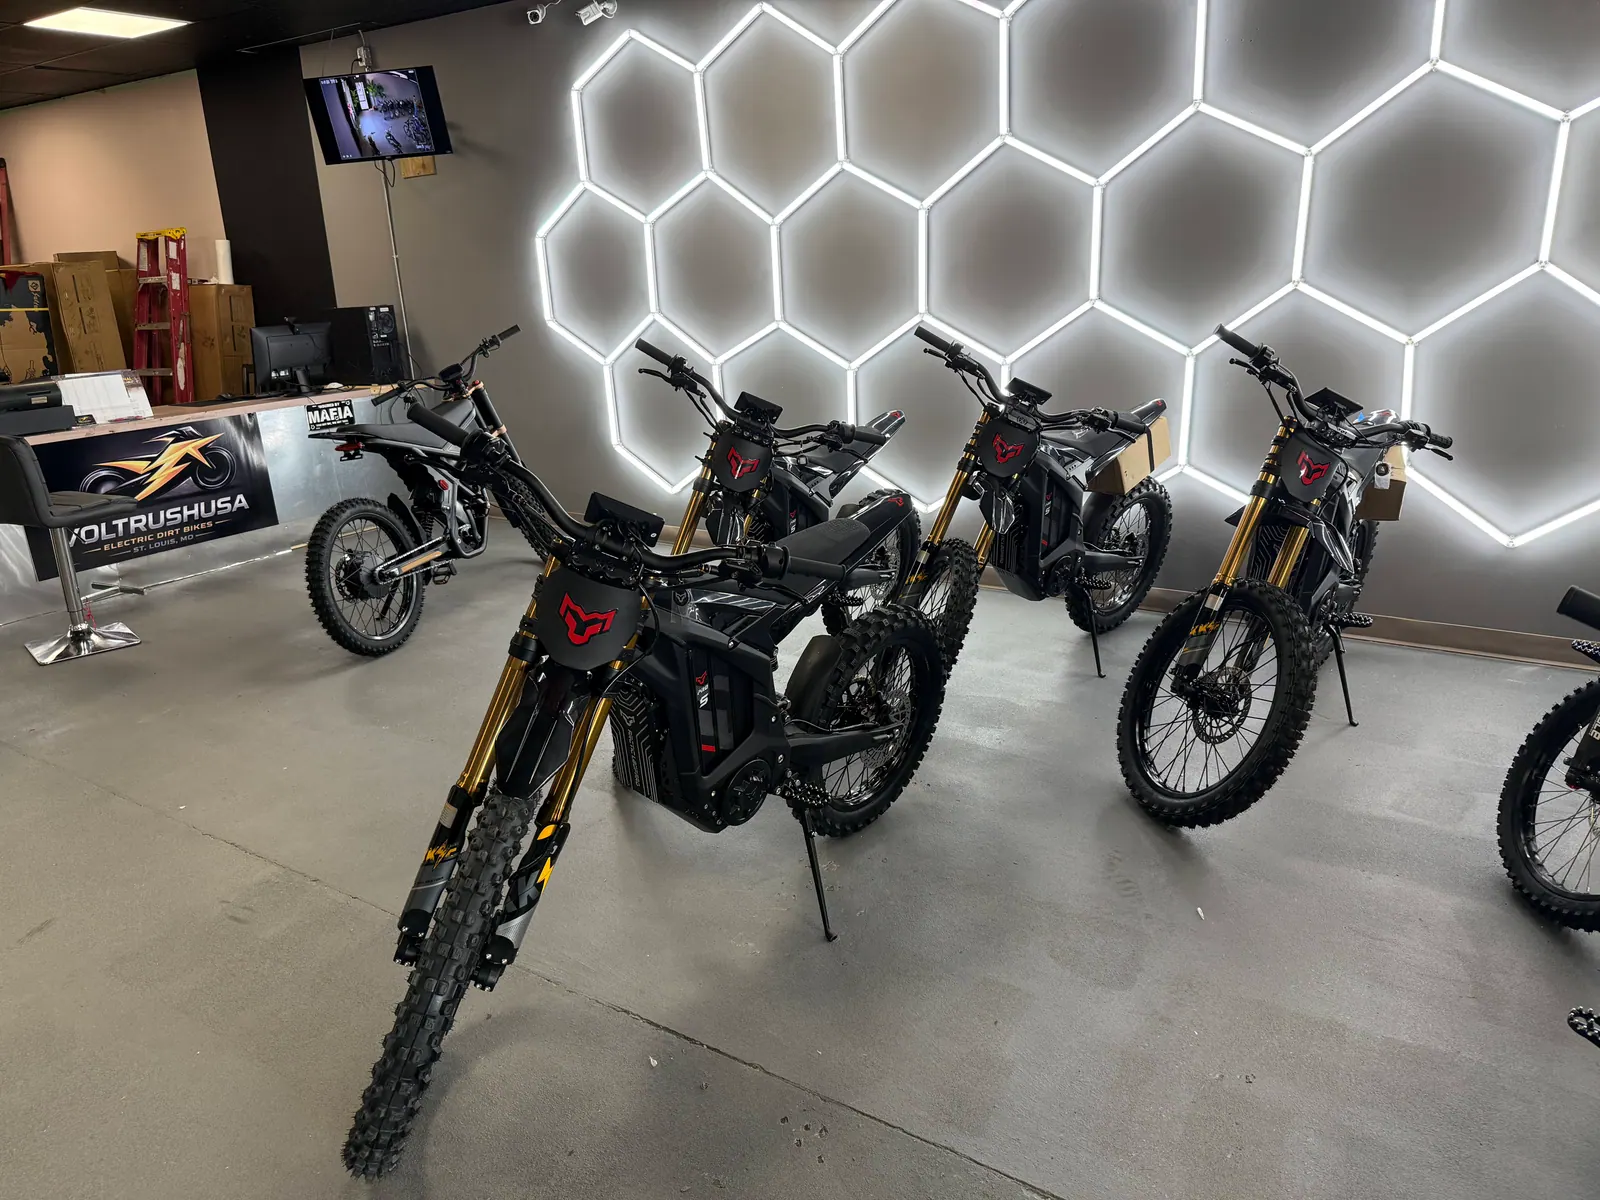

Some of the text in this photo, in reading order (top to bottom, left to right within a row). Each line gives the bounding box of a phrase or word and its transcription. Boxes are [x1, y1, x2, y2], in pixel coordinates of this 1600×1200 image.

[308, 406, 353, 424] MAFIA
[103, 521, 213, 551] ELECTRIC DIRT BIKES
[133, 534, 194, 553] ST. LOUIS, MO
